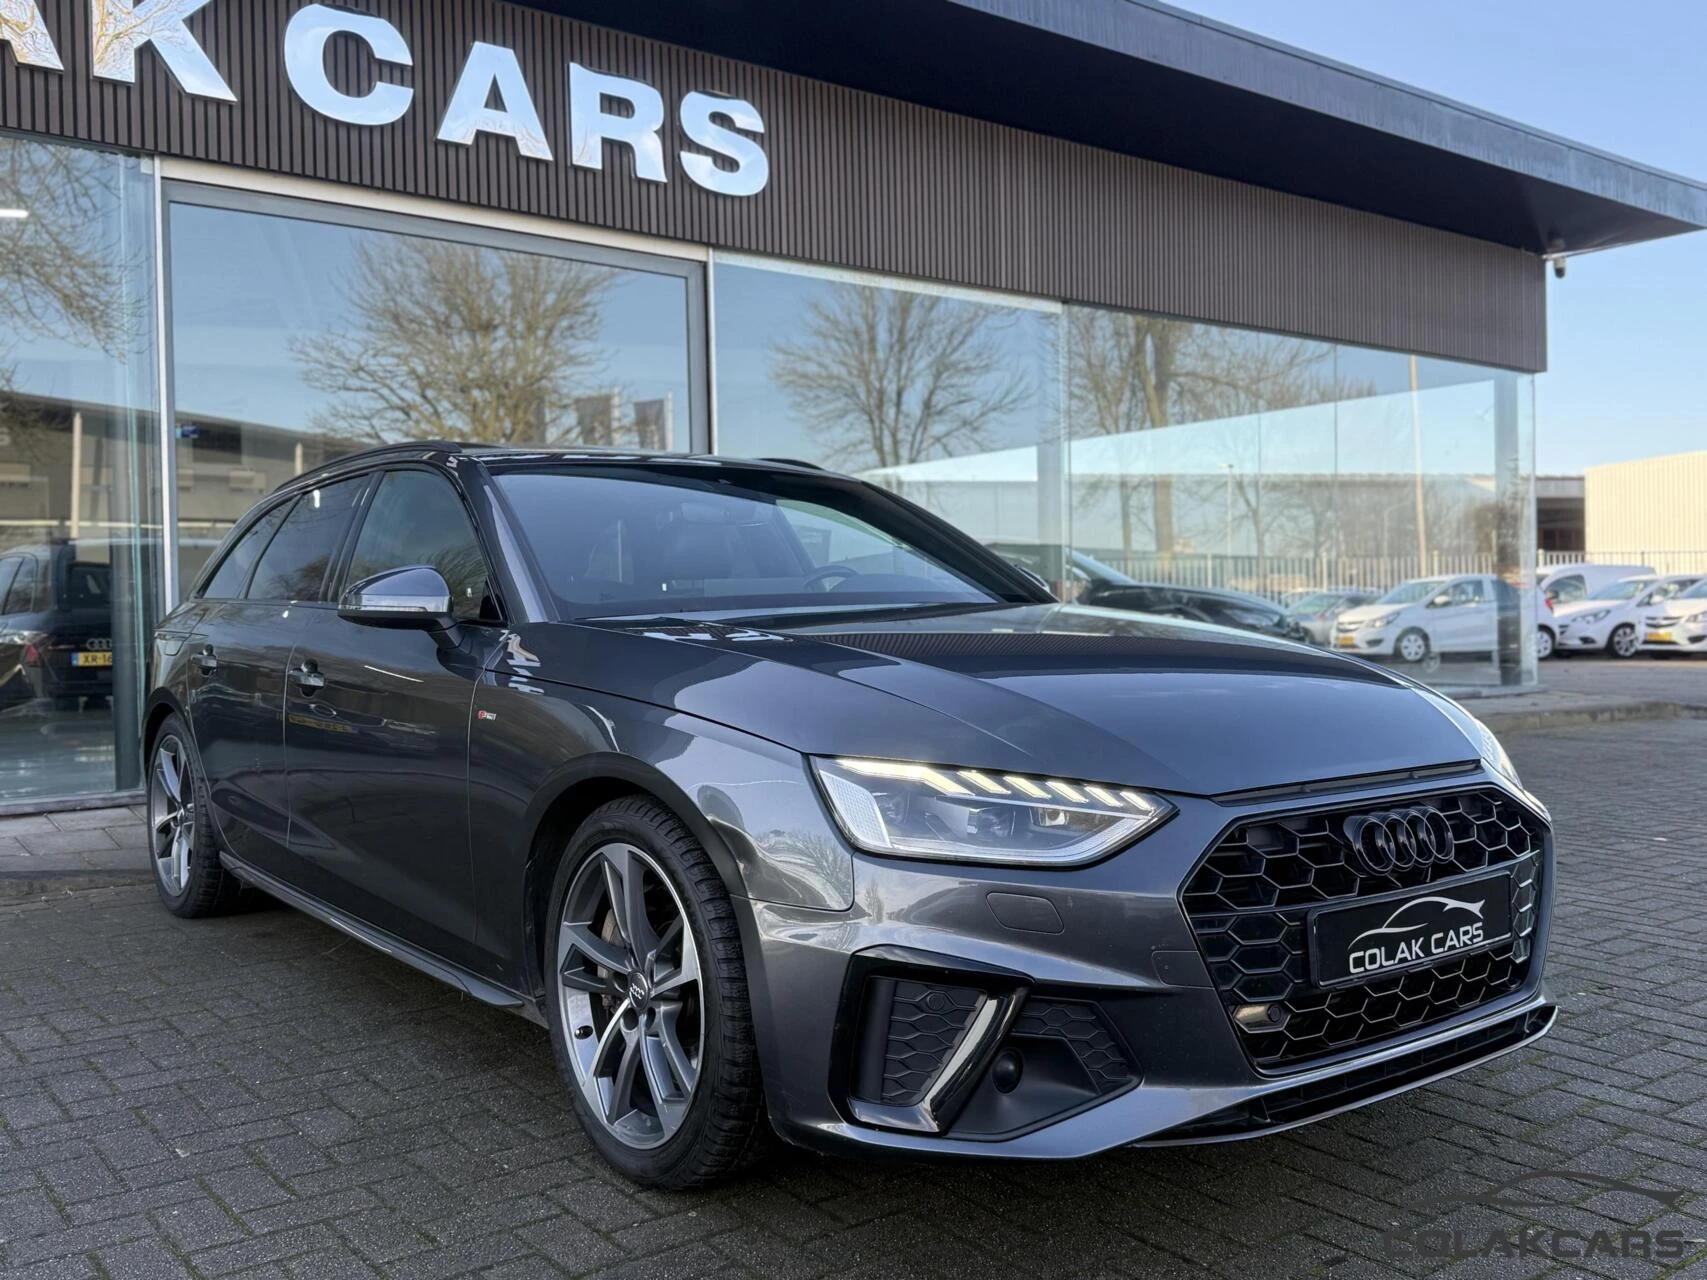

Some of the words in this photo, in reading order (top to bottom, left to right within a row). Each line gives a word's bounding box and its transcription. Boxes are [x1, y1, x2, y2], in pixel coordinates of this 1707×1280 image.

[284, 3, 769, 196] CARS
[1348, 936, 1425, 974] COLAK
[1430, 921, 1484, 955] CARS
